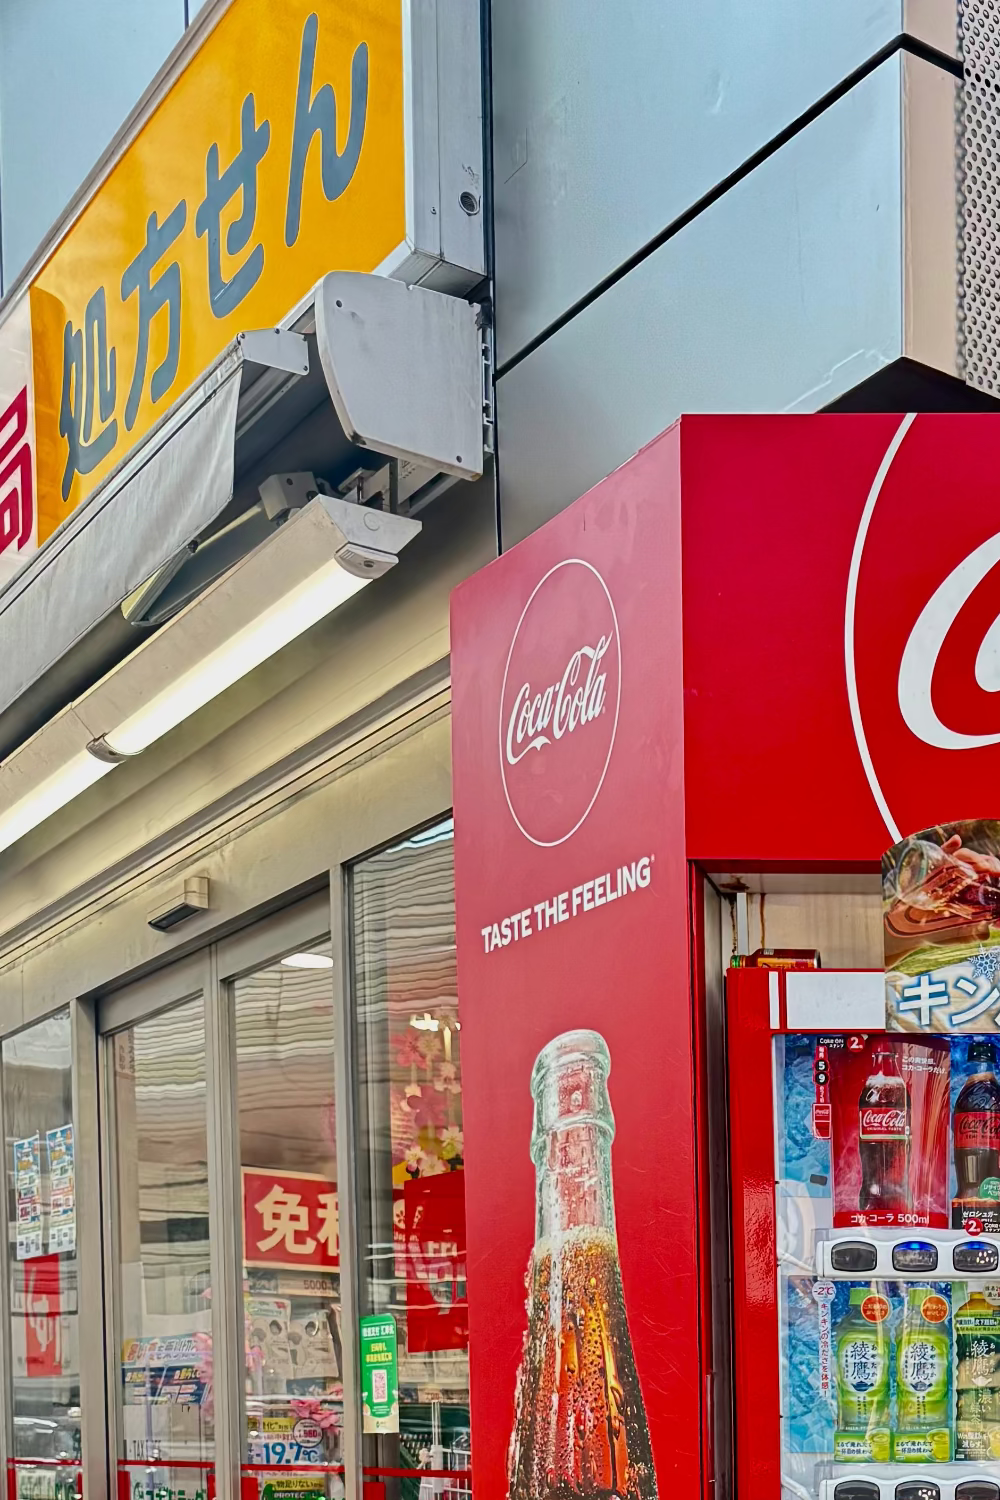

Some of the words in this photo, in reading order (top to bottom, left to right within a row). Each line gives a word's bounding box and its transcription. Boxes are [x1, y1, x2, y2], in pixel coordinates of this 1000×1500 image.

[59, 12, 369, 502] 処方せん
[506, 630, 613, 765] Coca-Cola
[481, 907, 533, 954] TASTE
[534, 894, 570, 930] THE
[571, 856, 651, 917] FEELING
[863, 1110, 905, 1127] Coca-Cola
[897, 1213, 930, 1225] 500ml
[962, 1210, 998, 1218] ゼロシュガー
[850, 1341, 871, 1381] 綾鷹
[910, 1341, 931, 1381] 綾鷹
[970, 1340, 989, 1376] 綾鷹
